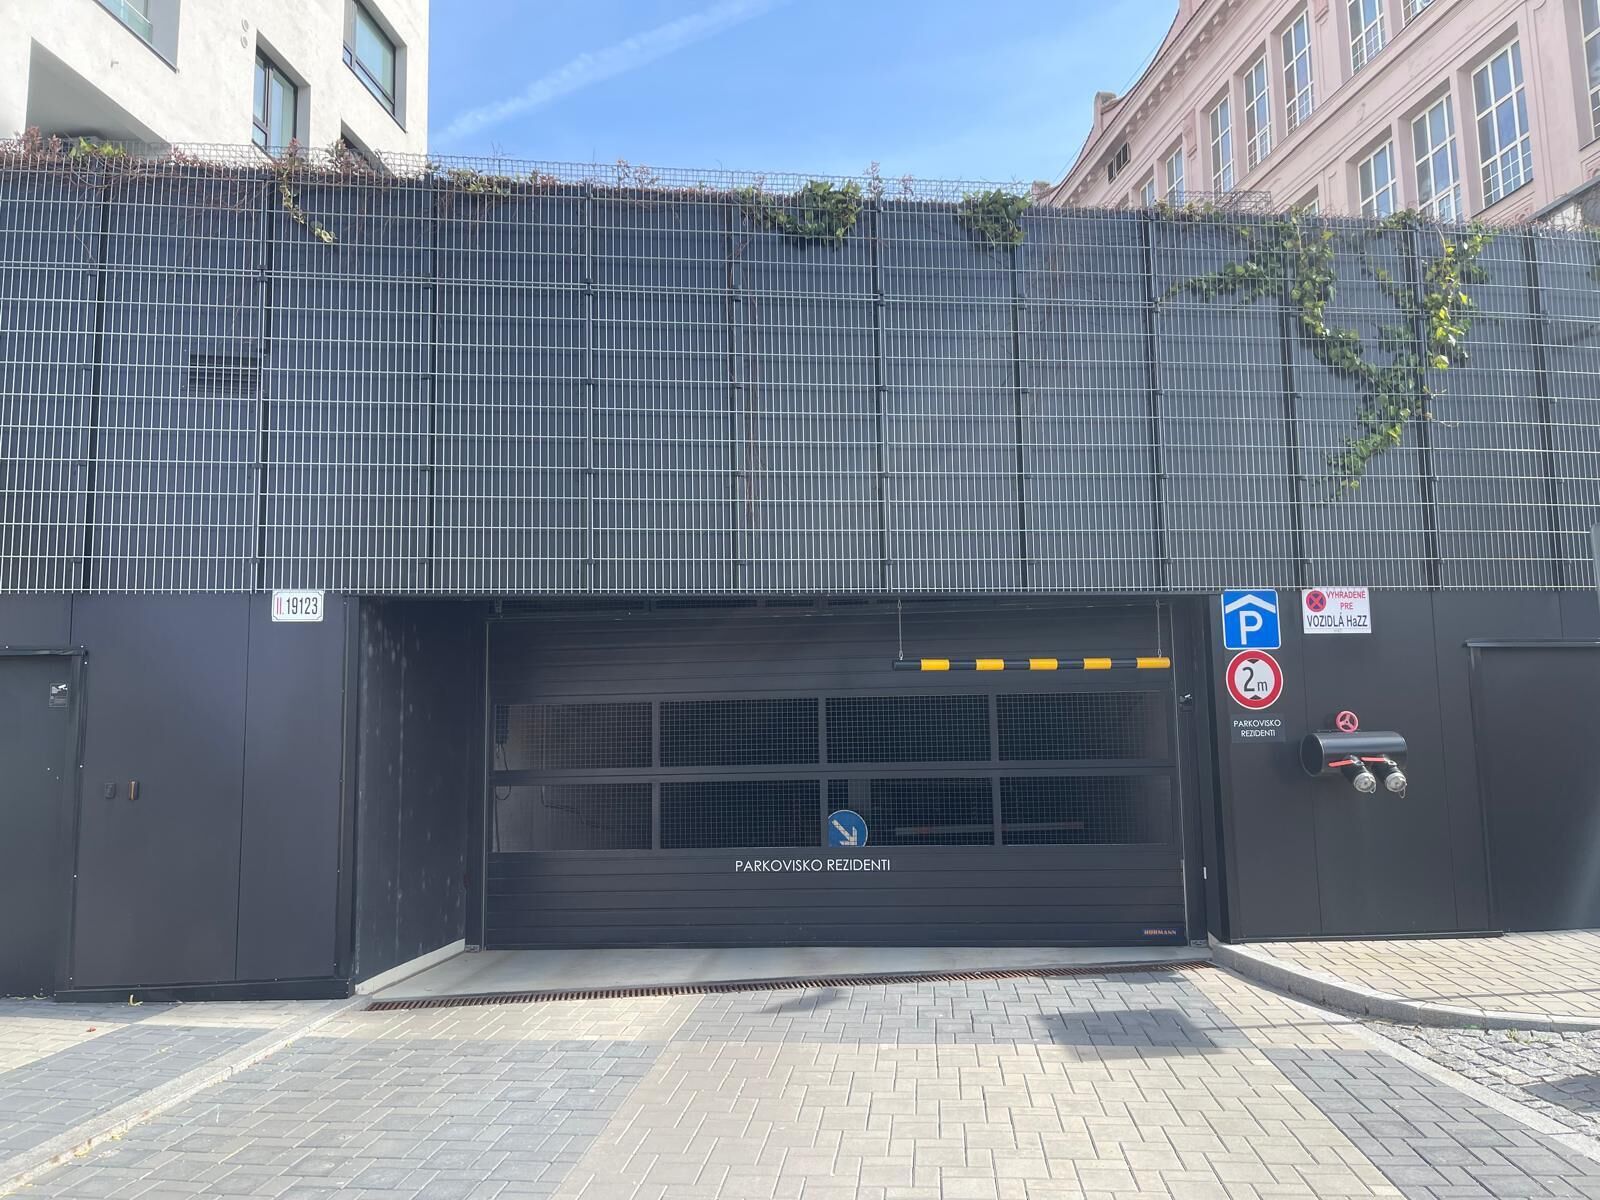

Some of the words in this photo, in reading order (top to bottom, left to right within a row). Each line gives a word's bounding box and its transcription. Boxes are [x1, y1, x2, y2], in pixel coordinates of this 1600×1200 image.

[1340, 602, 1354, 610] PRE
[1307, 612, 1345, 627] VOZIDLÁ
[1346, 615, 1368, 627] HaZZ
[1239, 610, 1263, 645] P
[1233, 720, 1281, 728] PARKOVISKO
[735, 859, 823, 872] PARKOVISKO
[827, 859, 891, 871] REZIDENTI
